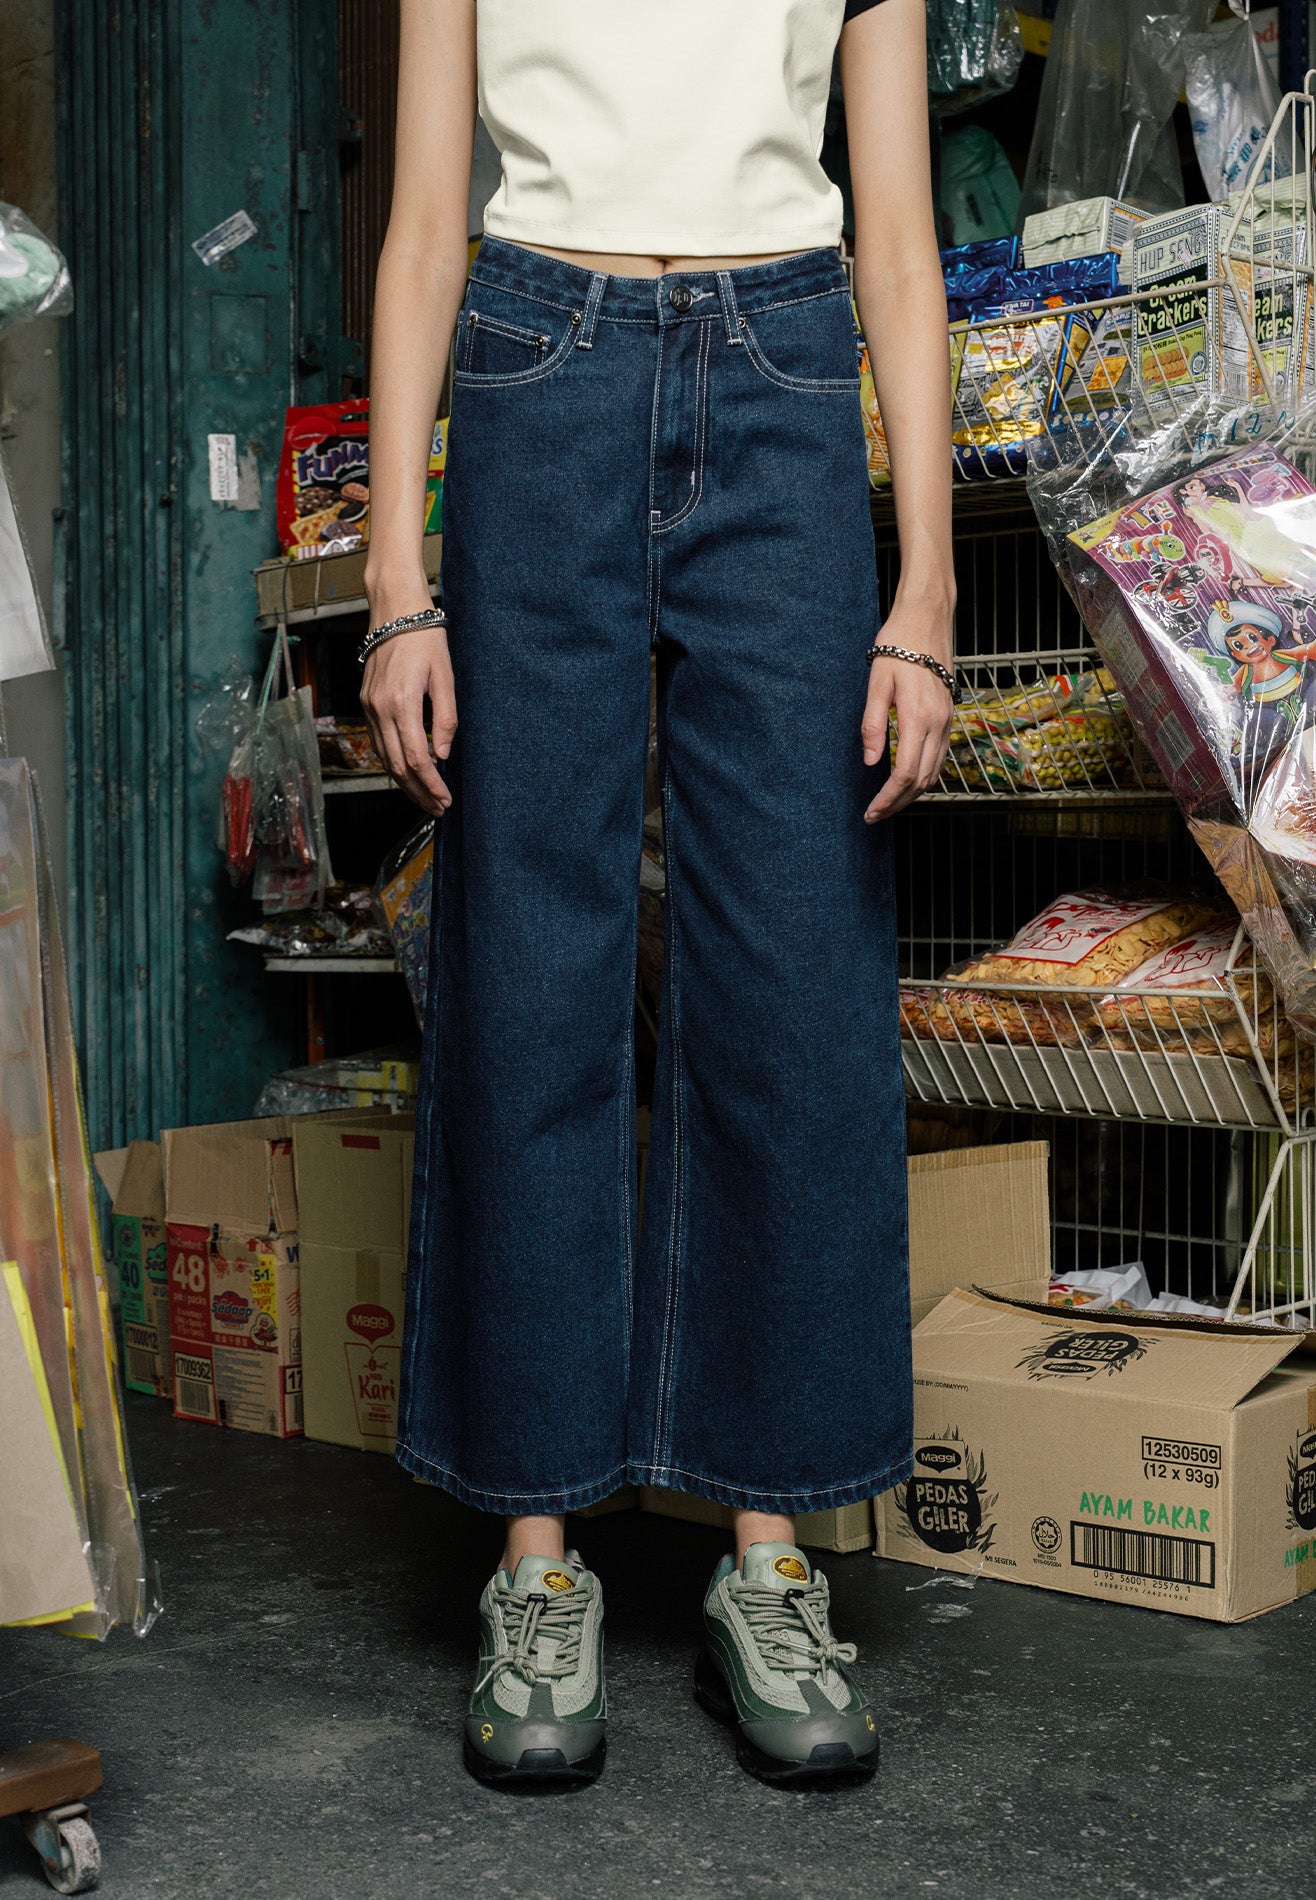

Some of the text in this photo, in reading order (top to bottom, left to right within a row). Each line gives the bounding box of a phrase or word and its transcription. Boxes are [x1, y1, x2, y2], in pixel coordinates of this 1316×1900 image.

[1140, 247, 1164, 273] HUP
[1150, 275, 1197, 308] Cream
[1138, 295, 1207, 336] Crackers
[1255, 293, 1283, 316] eam
[1257, 316, 1293, 342] kers
[297, 442, 369, 484] FUNM
[121, 1262, 140, 1289] 40
[145, 1257, 167, 1271] Sed
[173, 1253, 206, 1293] 48
[211, 1302, 253, 1318] Sedaap
[351, 1314, 390, 1329] Maggi
[1055, 1349, 1119, 1361] PEDAS
[358, 1374, 396, 1401] Kari
[920, 1452, 956, 1464] Maggi
[1145, 1441, 1218, 1464] 12530509
[1302, 1442, 1316, 1455] Mag
[1144, 1462, 1220, 1489] (12 x 93g)
[1298, 1469, 1316, 1492] PED
[915, 1483, 969, 1505] PEDAS
[1079, 1491, 1210, 1533] AYAM BAKAR
[994, 1556, 1017, 1567] SEGERA
[1284, 1543, 1309, 1569] AYAM
[1104, 1571, 1114, 1580] 95
[1120, 1575, 1147, 1587] 56001
[1152, 1580, 1180, 1592] 25576
